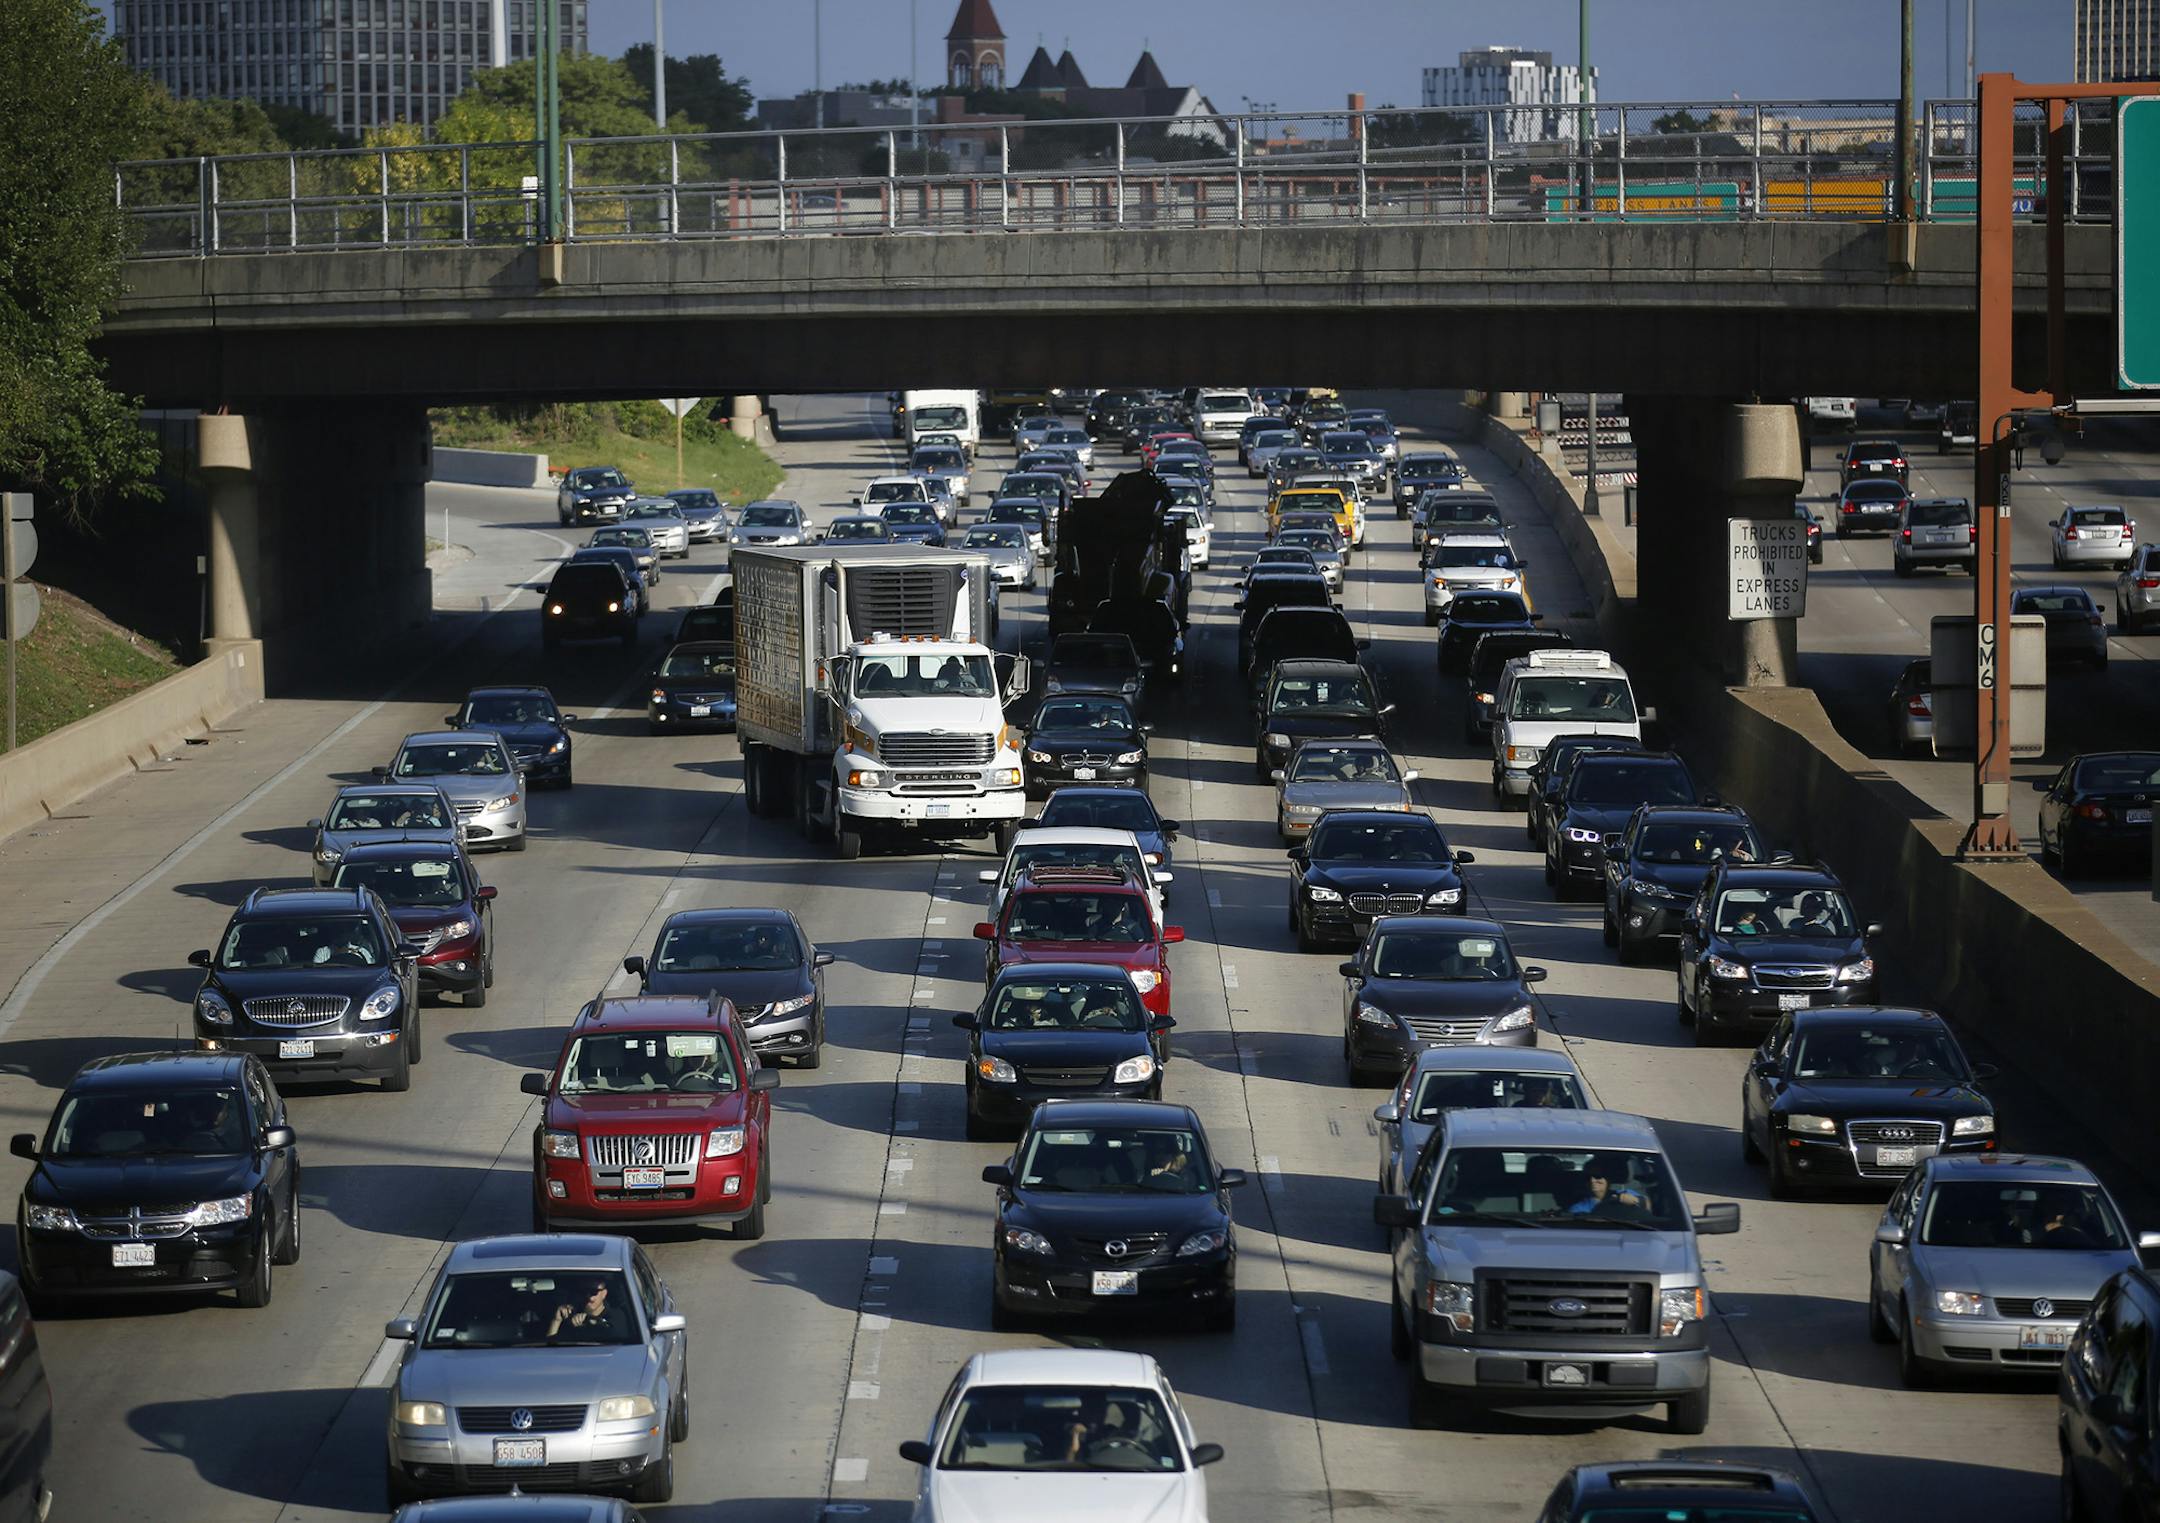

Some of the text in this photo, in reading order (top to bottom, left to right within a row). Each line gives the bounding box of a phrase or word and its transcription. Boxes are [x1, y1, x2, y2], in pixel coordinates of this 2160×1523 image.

[1742, 526, 1796, 541] TRUCKS
[1734, 545, 1803, 560] PROHIBITED
[1762, 561, 1775, 575] IN
[1737, 579, 1799, 593] EXPRESS
[1746, 596, 1790, 610] LANES
